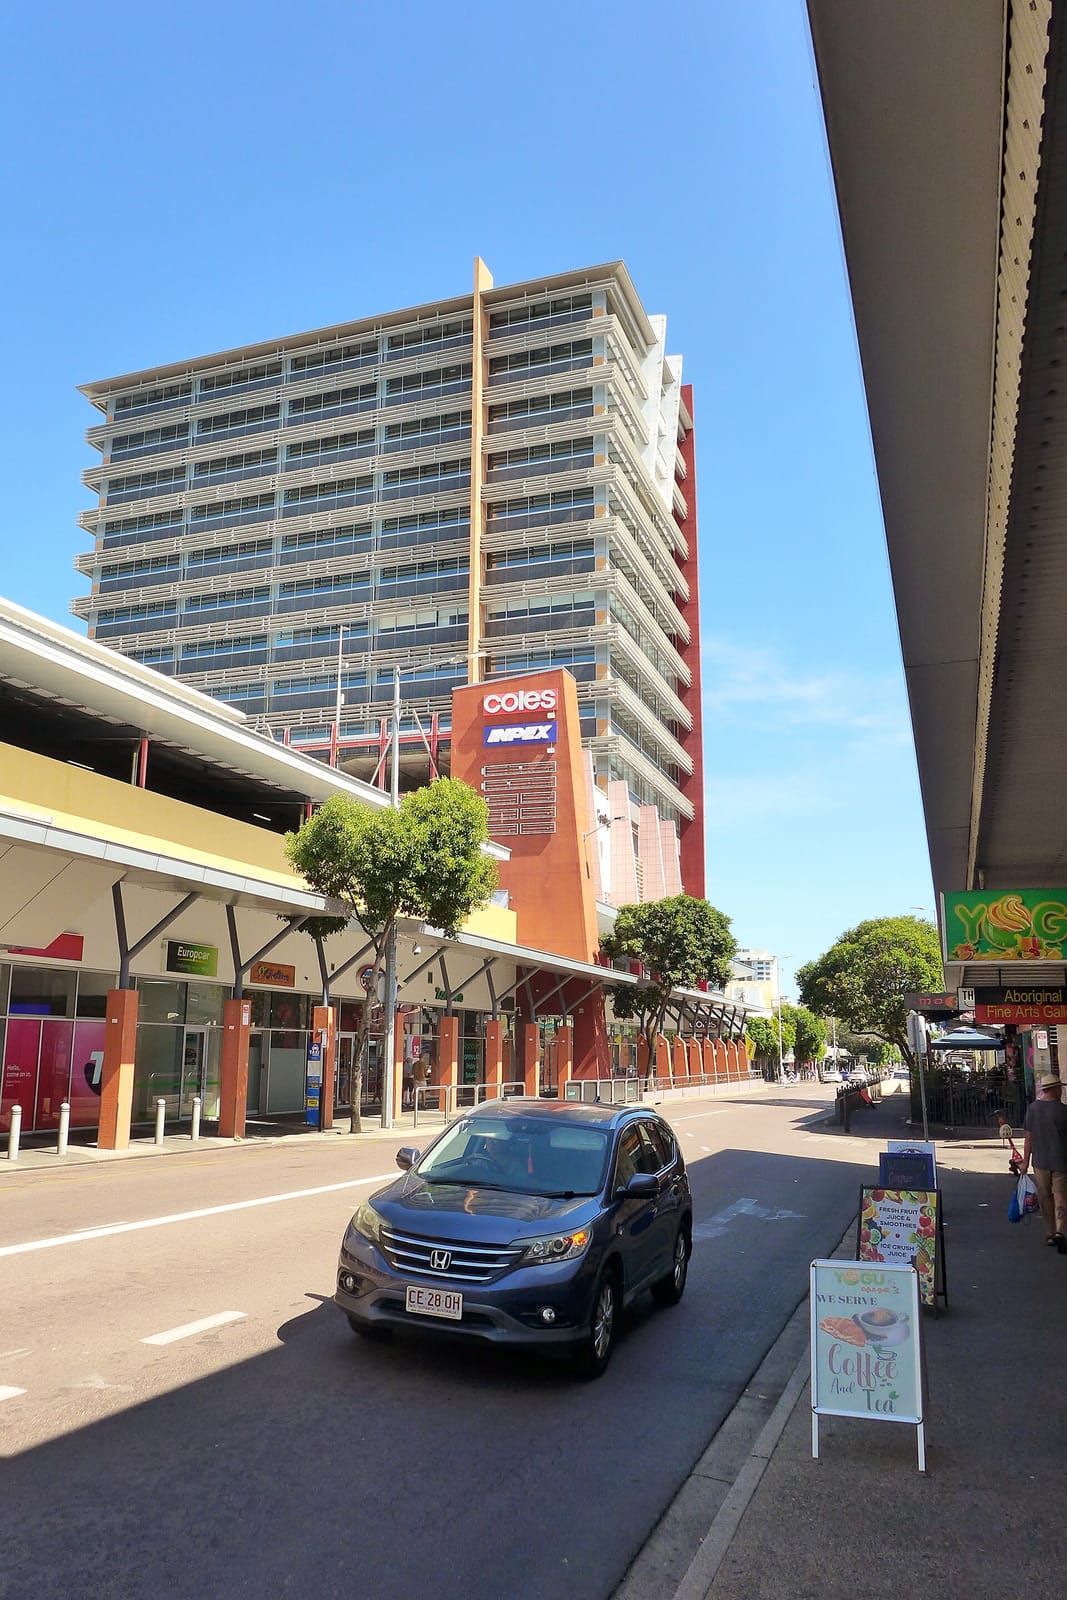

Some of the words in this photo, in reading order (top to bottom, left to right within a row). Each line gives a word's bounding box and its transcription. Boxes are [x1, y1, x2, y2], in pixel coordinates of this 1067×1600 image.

[483, 689, 556, 713] coles
[487, 725, 552, 743] INPEX
[177, 946, 210, 962] Europcar
[1004, 989, 1062, 1005] Aboriginal
[986, 1005, 1012, 1018] Fine
[1015, 1005, 1040, 1018] Arts
[879, 1220, 917, 1229] SMOOTHIES
[887, 1250, 907, 1258] JUICE
[892, 1243, 915, 1251] CRUSH
[408, 1290, 424, 1305] CE
[427, 1292, 441, 1307] 28
[816, 1293, 836, 1304] WE
[838, 1294, 878, 1306] SERVE
[828, 1343, 899, 1388] Coffee
[830, 1378, 855, 1395] And
[862, 1388, 896, 1413] Tea
